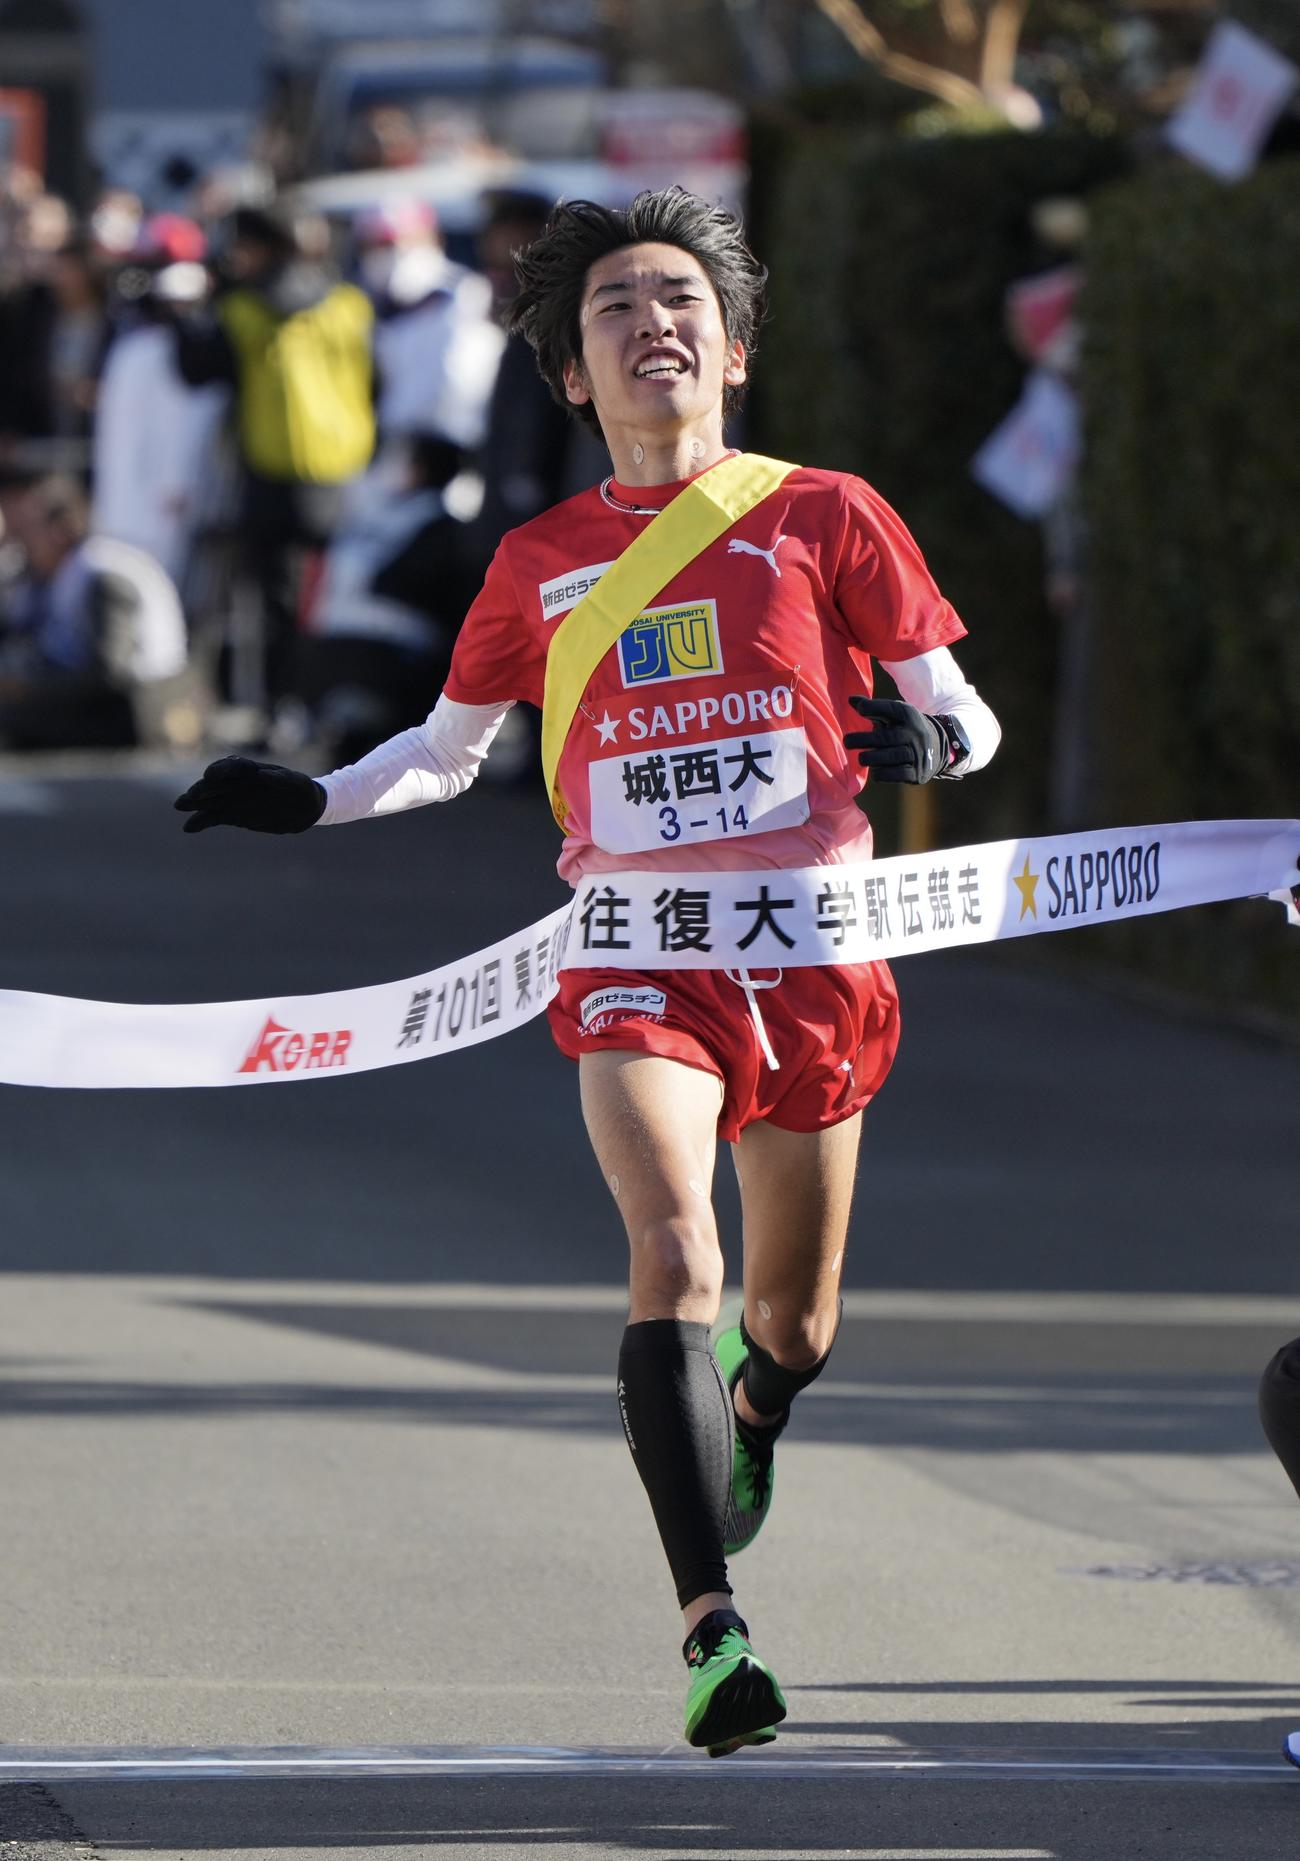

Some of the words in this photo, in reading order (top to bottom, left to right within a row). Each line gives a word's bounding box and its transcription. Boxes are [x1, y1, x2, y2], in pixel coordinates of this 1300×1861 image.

[656, 609, 705, 622] UNIVERSITY
[631, 617, 713, 679] JU
[629, 685, 793, 740] SAPPORO
[622, 740, 774, 806] 城西大
[1046, 842, 1160, 919] SAPPORO
[397, 957, 501, 1049] 第101回
